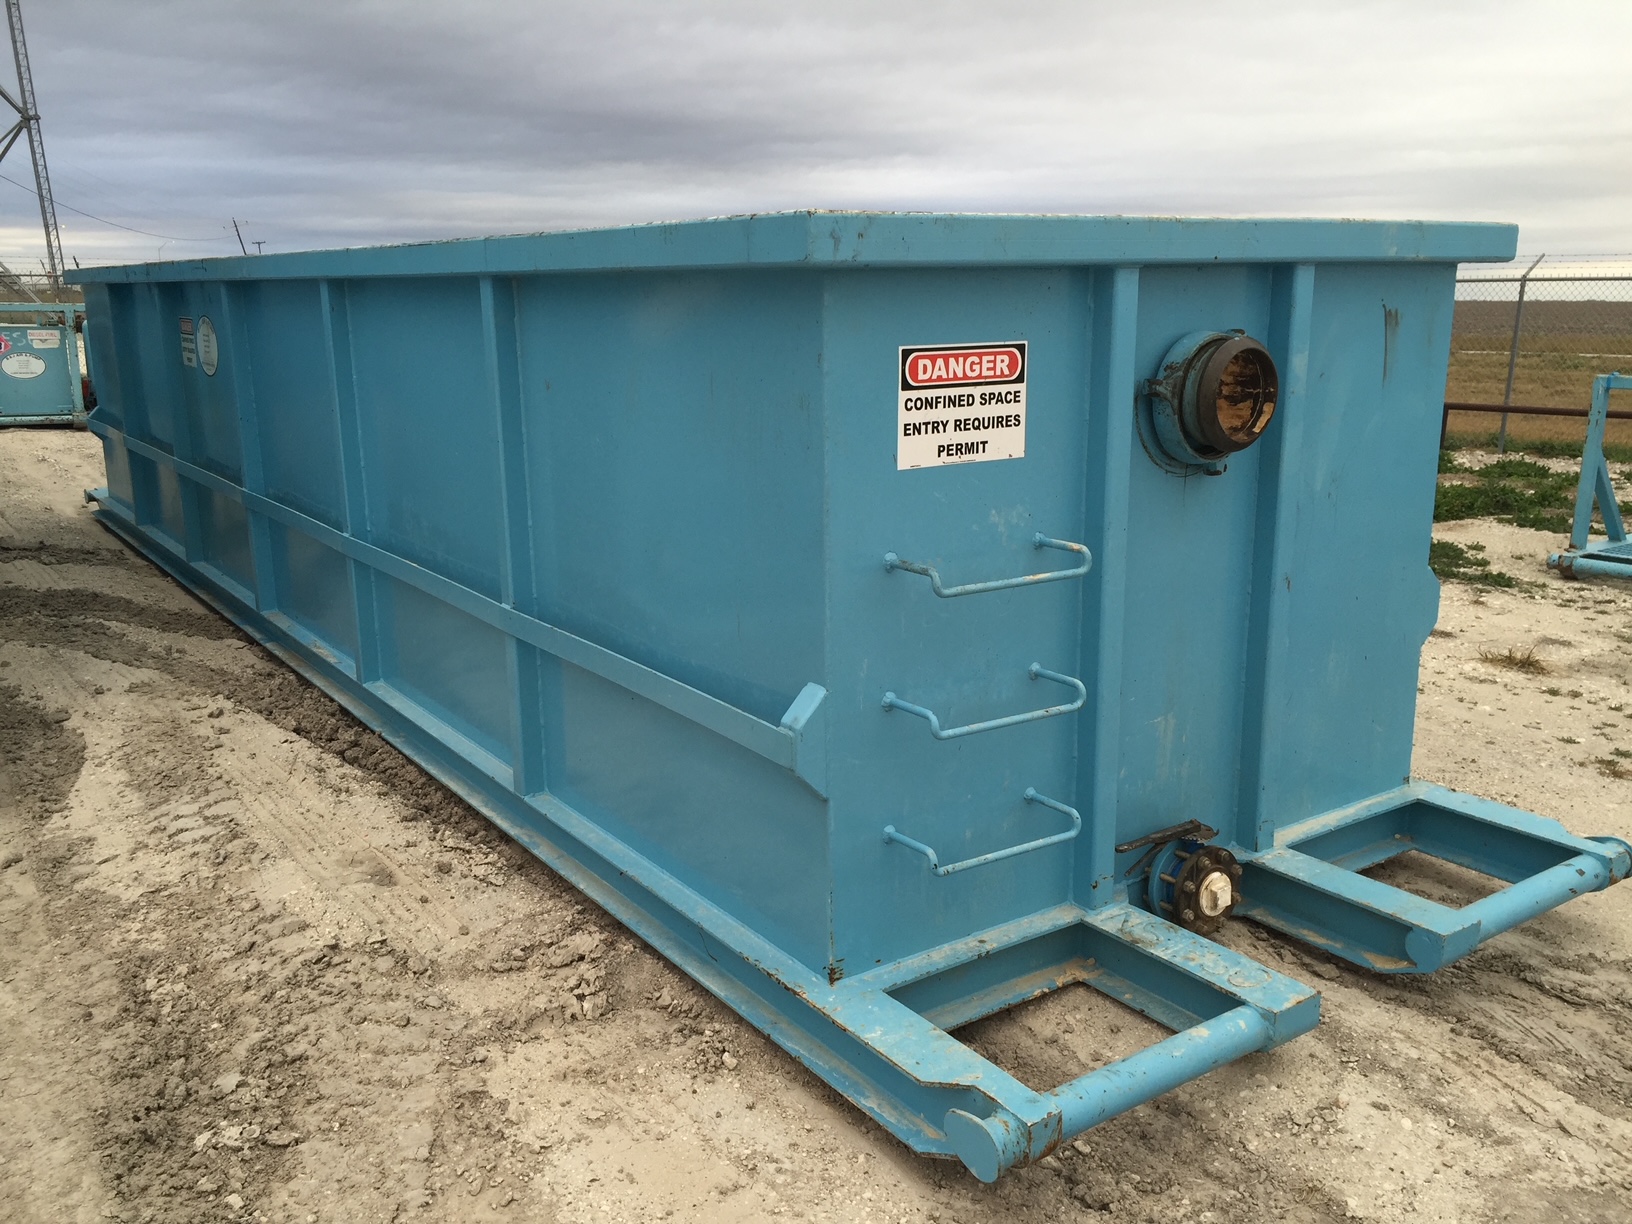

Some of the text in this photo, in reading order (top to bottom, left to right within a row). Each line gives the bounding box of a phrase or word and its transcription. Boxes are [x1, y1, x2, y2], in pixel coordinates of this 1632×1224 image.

[918, 355, 1010, 380] DANGER
[904, 390, 1021, 412] CONFINED SPACE
[903, 414, 1021, 437] ENTRY REQUIRES
[937, 440, 988, 458] PERMIT
